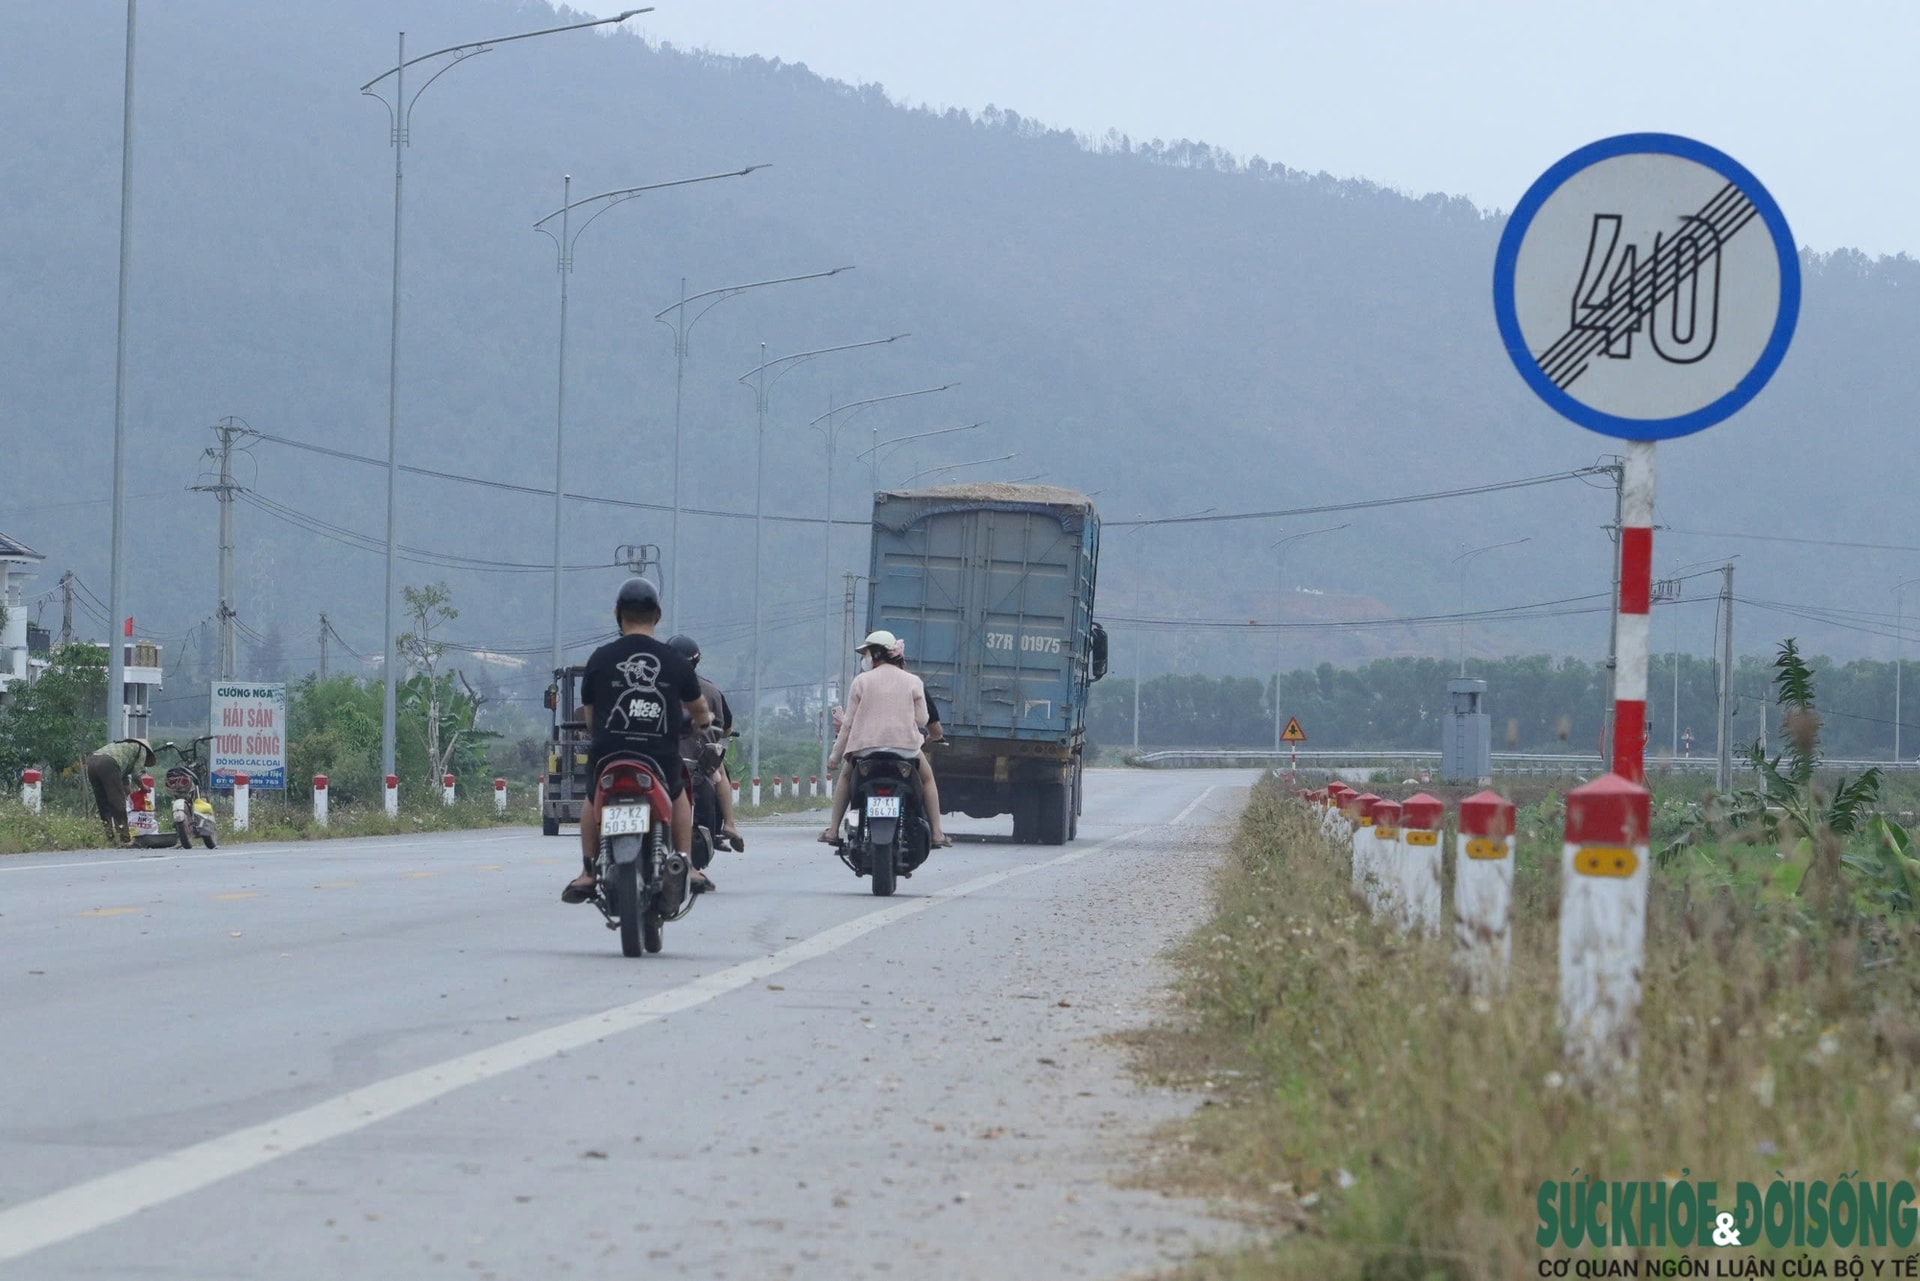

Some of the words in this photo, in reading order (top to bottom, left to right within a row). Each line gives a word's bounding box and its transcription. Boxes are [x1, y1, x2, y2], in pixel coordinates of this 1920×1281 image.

[1571, 213, 1722, 365] 40
[986, 632, 1014, 650] 37R
[1021, 635, 1060, 654] 01975
[217, 686, 251, 698] CƯỜNG
[252, 688, 273, 698] NGA
[223, 702, 244, 727] HẢI
[247, 702, 273, 728] SẢN
[216, 733, 242, 755] TƯƠI
[246, 729, 280, 756] SỐNG
[609, 806, 642, 820] 37-K2
